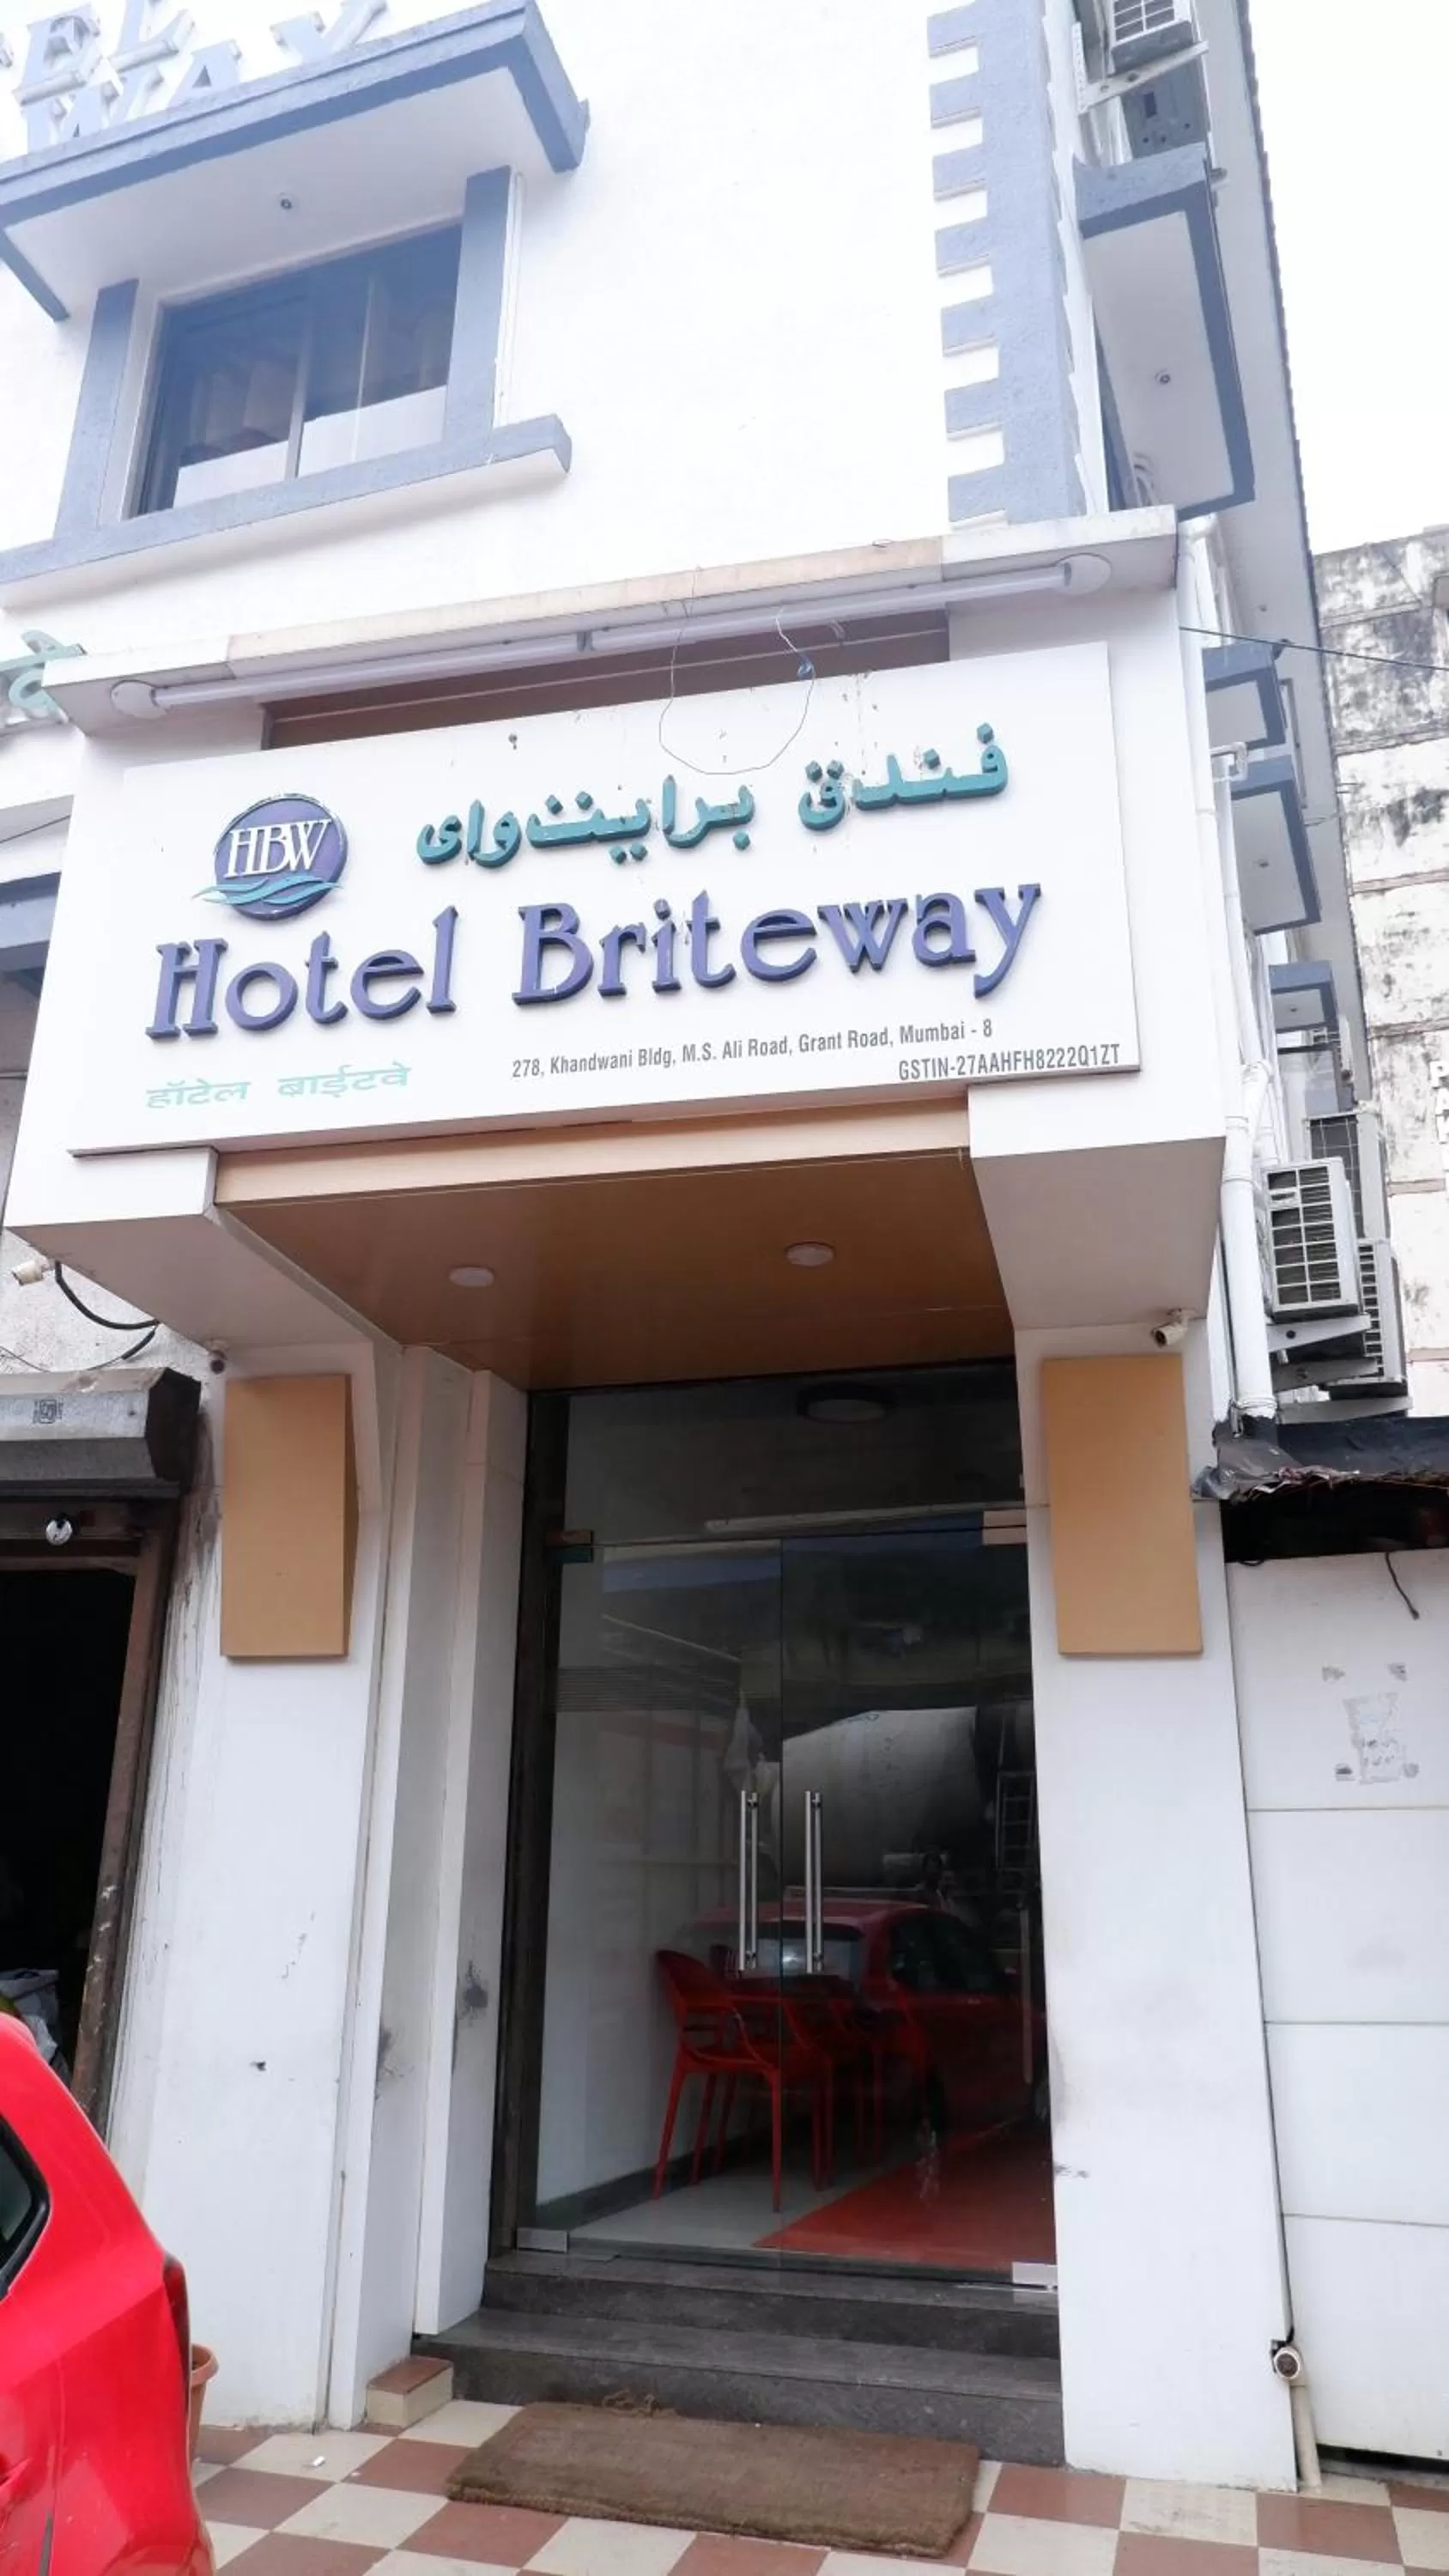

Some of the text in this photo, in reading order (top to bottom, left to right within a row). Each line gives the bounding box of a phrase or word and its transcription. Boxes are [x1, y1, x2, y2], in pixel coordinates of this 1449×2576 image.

[797, 722, 1009, 833] فندق
[222, 818, 333, 879] HBW
[145, 882, 1042, 1042] Hotel Briteway
[512, 1057, 546, 1078] 278,
[549, 1048, 633, 1075] Khandwani
[637, 1045, 677, 1069] Bldg,
[682, 1041, 718, 1064] M.S.
[722, 1038, 743, 1060] Ali
[748, 1034, 793, 1057] Road,
[798, 1030, 843, 1054] Grant
[846, 1028, 894, 1049] Road,
[900, 1020, 967, 1045] Mumbai
[982, 1018, 993, 1038] 8
